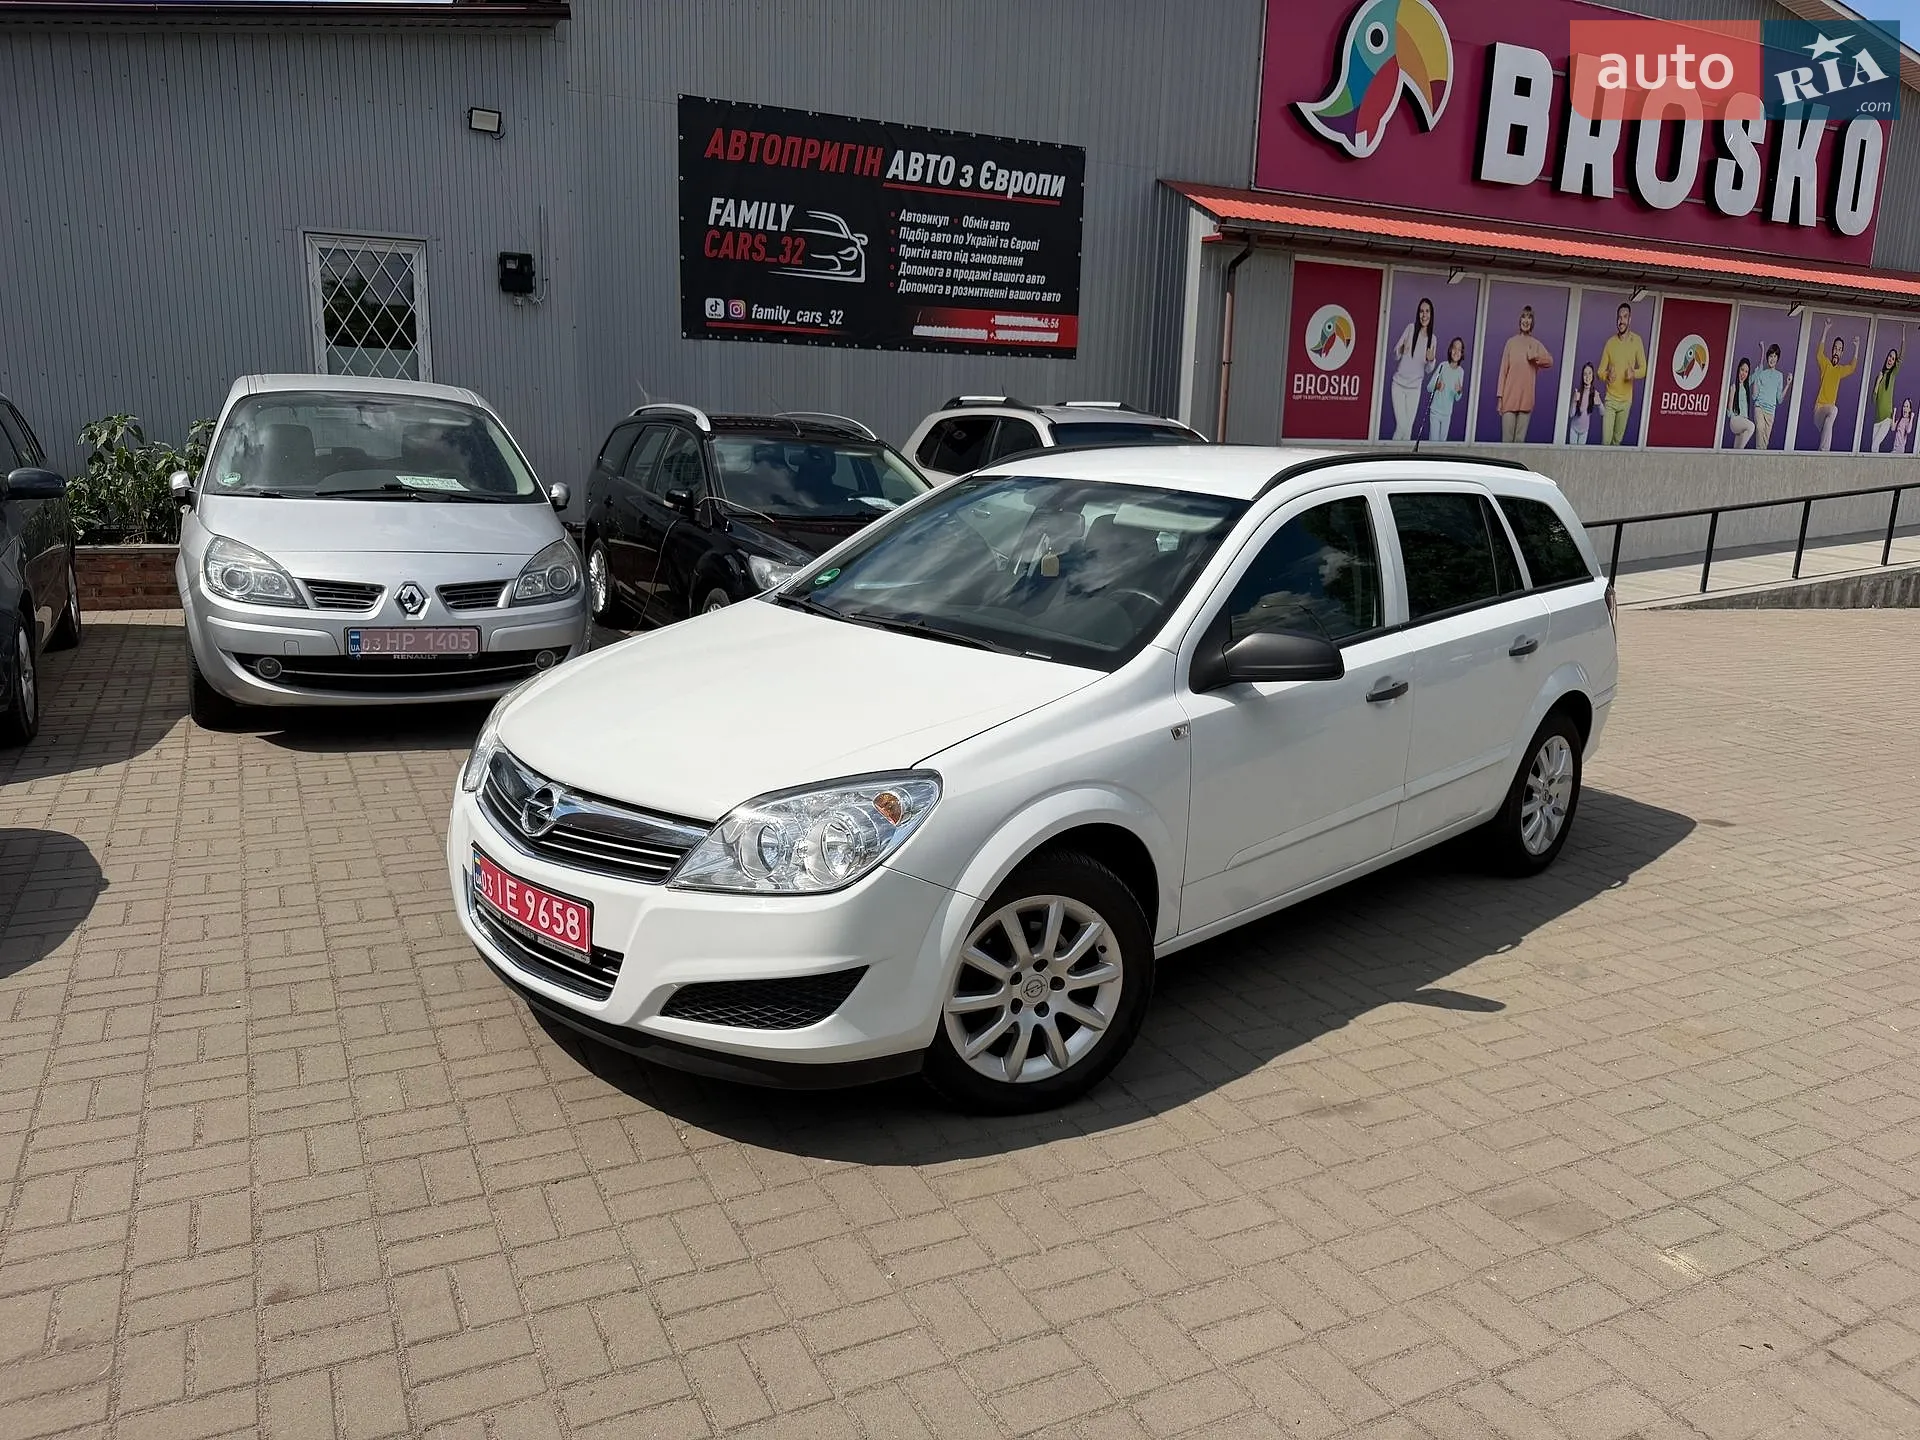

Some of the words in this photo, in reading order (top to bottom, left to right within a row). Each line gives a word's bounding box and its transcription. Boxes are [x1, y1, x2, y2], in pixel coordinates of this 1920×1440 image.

[1480, 41, 1883, 237] BROSKO
[704, 127, 884, 177] АВТОПРИГІН
[886, 150, 956, 186] АВТО
[979, 160, 1066, 199] Європи
[708, 197, 794, 232] FAMILY
[899, 208, 949, 228] Автовикуп
[962, 215, 988, 230] Обмін
[990, 220, 1010, 232] авто
[704, 229, 806, 265] CARS_32
[899, 226, 929, 244] Підбір
[930, 232, 951, 244] авто
[953, 234, 964, 245] по
[965, 232, 999, 248] Україні
[999, 238, 1009, 249] та
[1010, 237, 1040, 252] Європі
[899, 244, 930, 259] Пригін
[931, 249, 952, 261] авто
[953, 249, 969, 264] під
[970, 253, 1024, 266] замовлення
[898, 262, 944, 277] Допомога
[945, 268, 952, 278] в
[953, 268, 992, 282] продажі
[992, 271, 1025, 284] вашого
[1026, 274, 1046, 285] авто
[897, 279, 943, 294] Допомога
[945, 285, 951, 295] в
[952, 285, 1008, 299] розмитненні
[1009, 289, 1040, 301] вашого
[1041, 292, 1061, 303] авто
[751, 304, 844, 327] family_cars_32
[1293, 373, 1360, 396] BROSKO
[1661, 392, 1710, 412] BROSKO
[424, 632, 471, 650] 1405
[481, 870, 493, 898] 03
[525, 889, 581, 941] 9658
